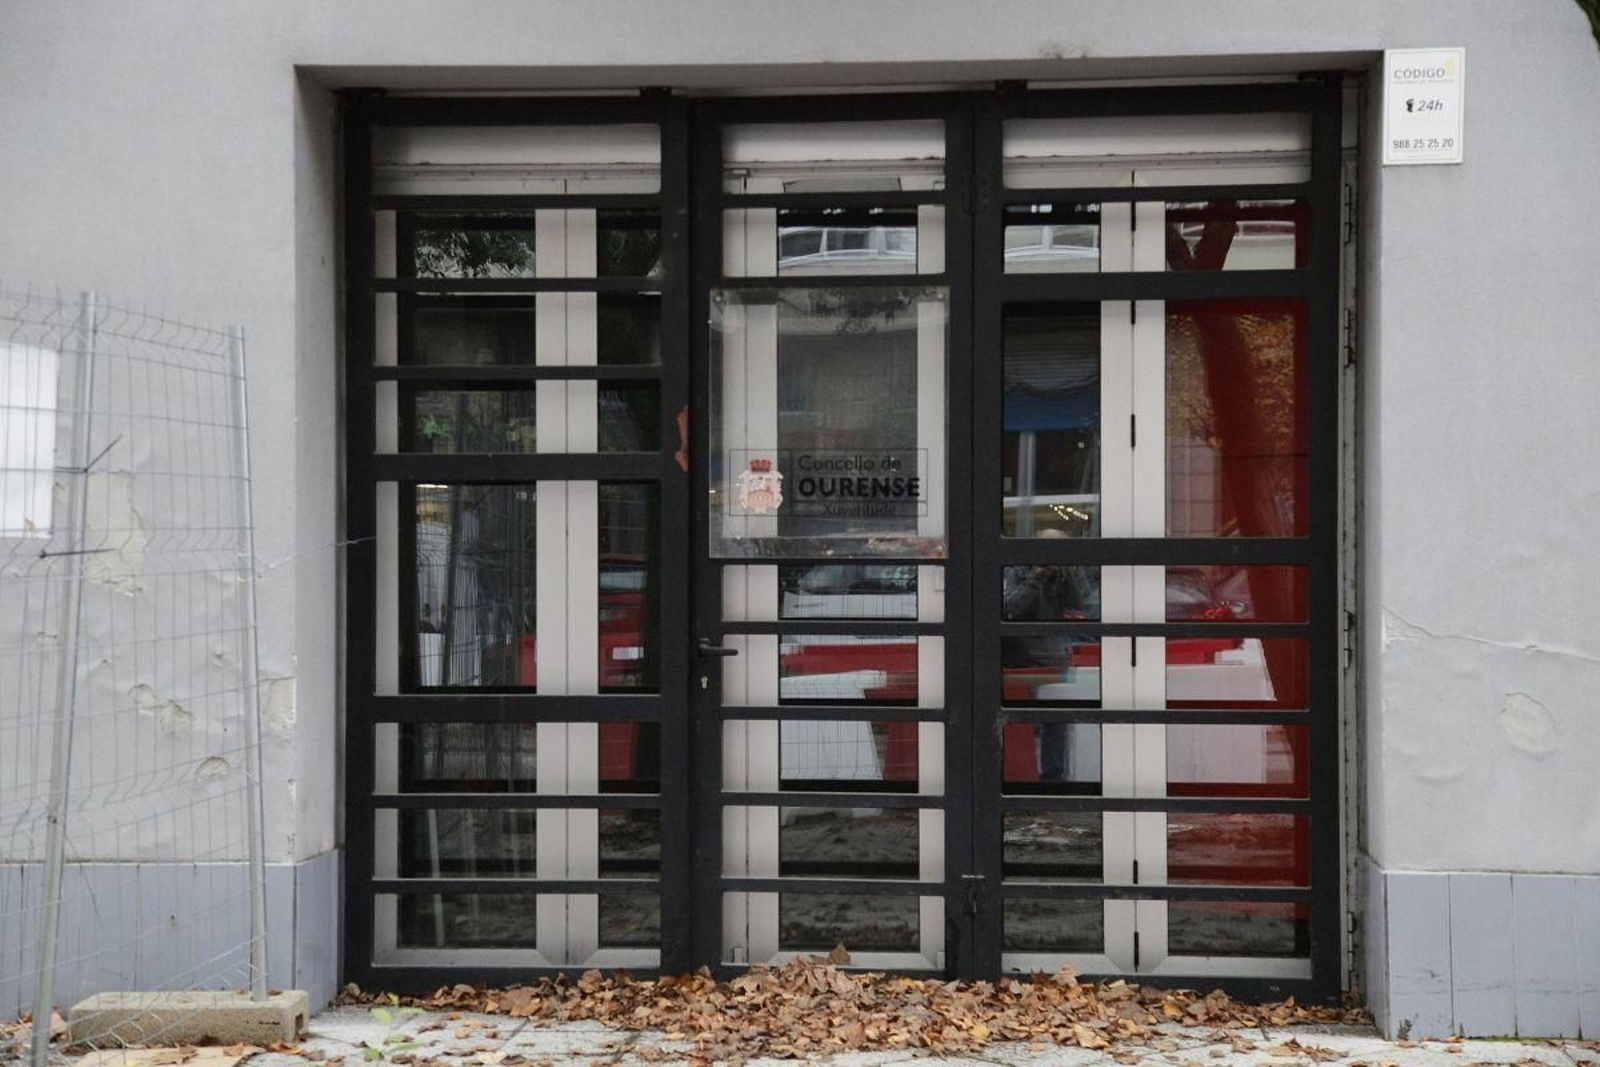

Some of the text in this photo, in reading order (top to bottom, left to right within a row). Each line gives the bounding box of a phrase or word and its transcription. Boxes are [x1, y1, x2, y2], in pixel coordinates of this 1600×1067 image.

[1394, 68, 1446, 79] CODIGO
[1417, 99, 1443, 112] 24h
[1392, 138, 1454, 149] 988 25 25 20
[799, 455, 902, 471] Concello de
[799, 478, 920, 497] OURENSE
